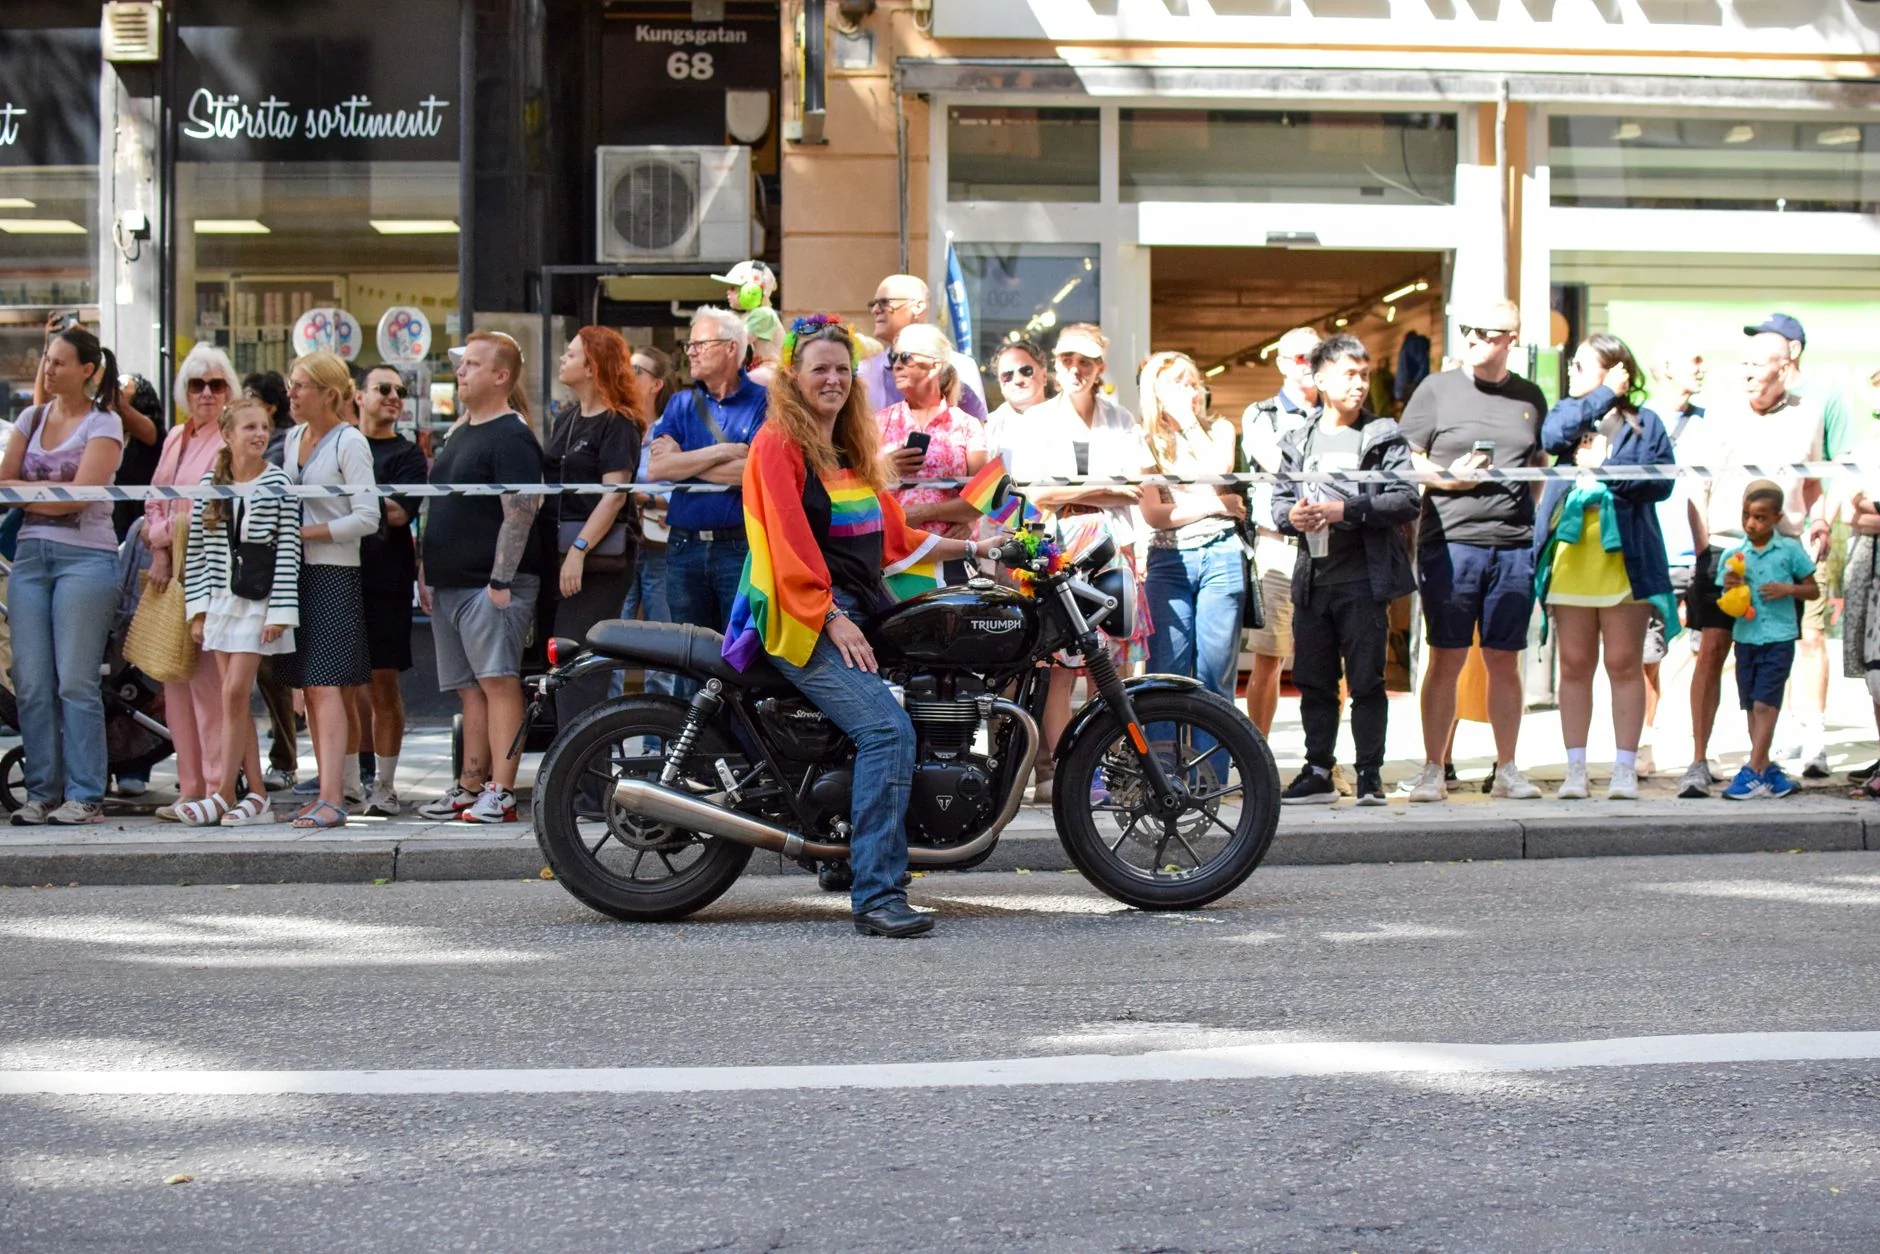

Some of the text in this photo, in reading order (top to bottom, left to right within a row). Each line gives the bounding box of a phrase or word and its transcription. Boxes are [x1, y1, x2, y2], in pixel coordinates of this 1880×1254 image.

[635, 25, 748, 46] Kungsgatan
[666, 51, 715, 80] 68
[184, 88, 450, 139] Största sortiment
[971, 619, 1021, 632] TRIUMPH
